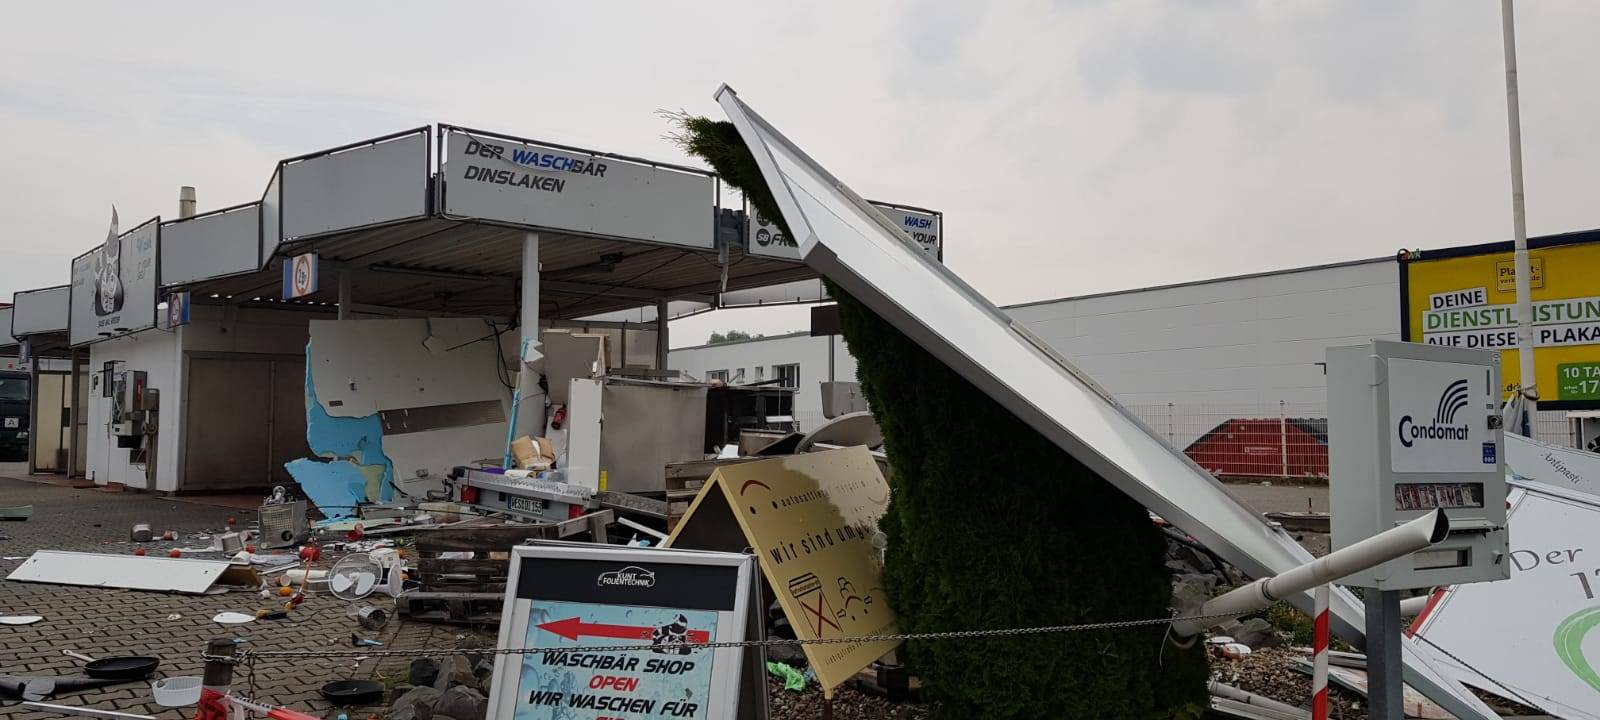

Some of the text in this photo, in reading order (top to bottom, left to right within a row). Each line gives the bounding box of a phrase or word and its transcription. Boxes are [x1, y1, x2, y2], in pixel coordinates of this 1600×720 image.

[464, 140, 608, 178] DER WASCHBÄR
[463, 165, 566, 193] DINSLAKEN
[904, 215, 933, 230] WASH
[757, 233, 770, 242] SB
[912, 232, 938, 246] YOUR
[1432, 290, 1484, 310] DEINE
[1427, 301, 1600, 330] DIENSTLISTUN
[1467, 331, 1520, 348] DIESE
[1541, 326, 1600, 344] PLAKA
[1562, 367, 1580, 379] 10
[1398, 415, 1470, 448] Condomat
[770, 541, 798, 565] wir
[801, 527, 835, 555] sind
[1510, 548, 1584, 572] Der
[603, 577, 650, 586] FOLIENTECHNIK
[617, 573, 638, 581] KUNT
[542, 651, 695, 676] WASCHBÄR SHOP
[588, 675, 639, 692] OPEN
[528, 689, 699, 718] WIR WASCHEN FÜR
